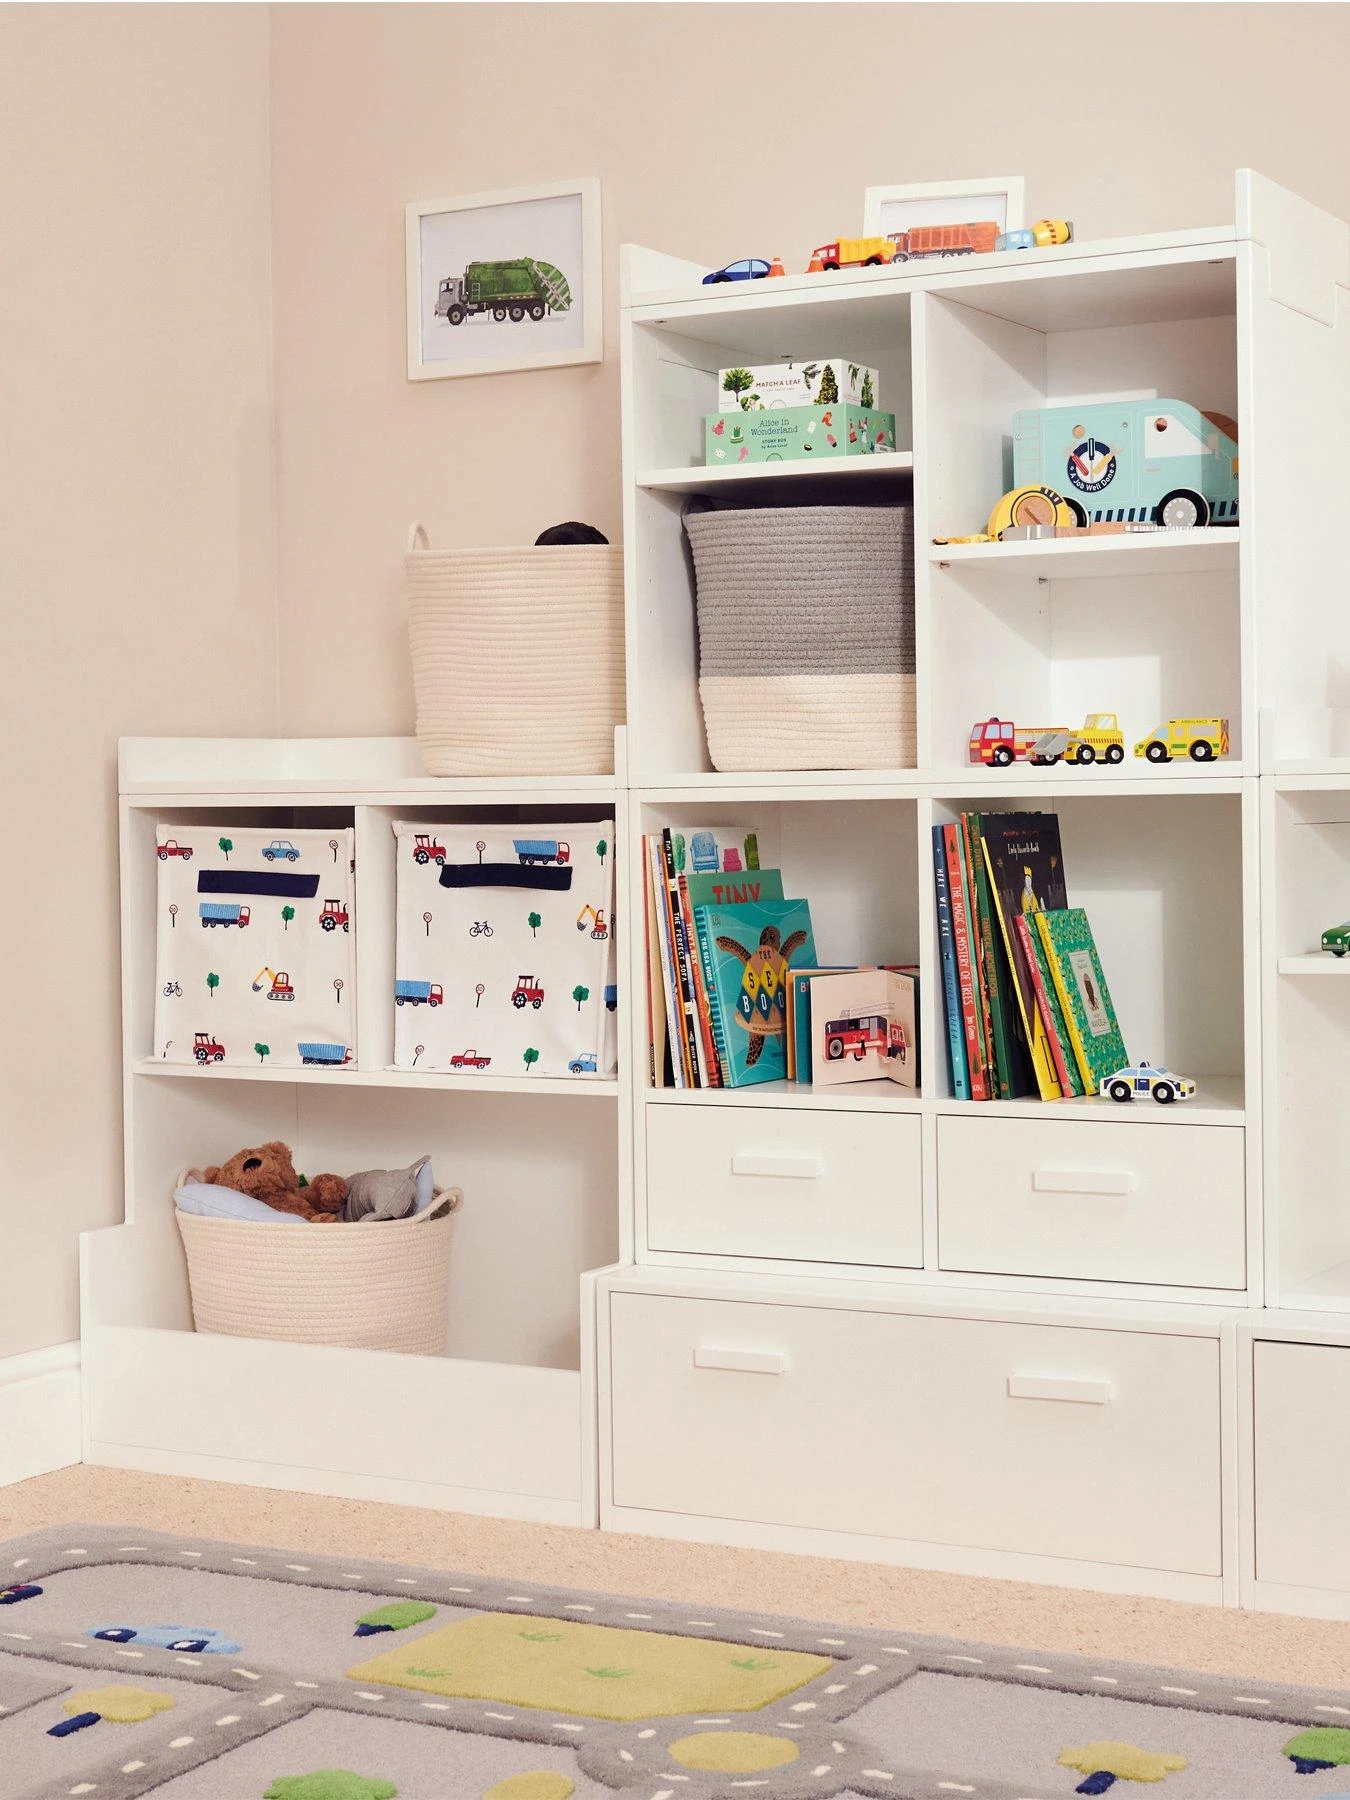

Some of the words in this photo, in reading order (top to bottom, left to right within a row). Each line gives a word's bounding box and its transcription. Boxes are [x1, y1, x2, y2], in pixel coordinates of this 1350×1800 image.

[750, 425, 798, 436] Wonderland
[759, 419, 780, 427] Alice
[1073, 479, 1085, 489] Job
[1085, 483, 1102, 491] Well
[1101, 469, 1115, 487] Done
[939, 897, 946, 908] WE
[951, 886, 962, 901] THE
[953, 902, 964, 924] MAGIC
[941, 919, 949, 937] ARE
[676, 927, 685, 962] PERFECT
[686, 923, 694, 941] TINY
[690, 949, 698, 965] REX
[957, 937, 969, 969] MYSTERY
[680, 964, 688, 982] SOFA
[961, 971, 971, 982] OF
[962, 984, 973, 1005] TREES
[1037, 988, 1047, 1011] CHARLES
[966, 1016, 974, 1025] Jen
[968, 1025, 976, 1040] Green
